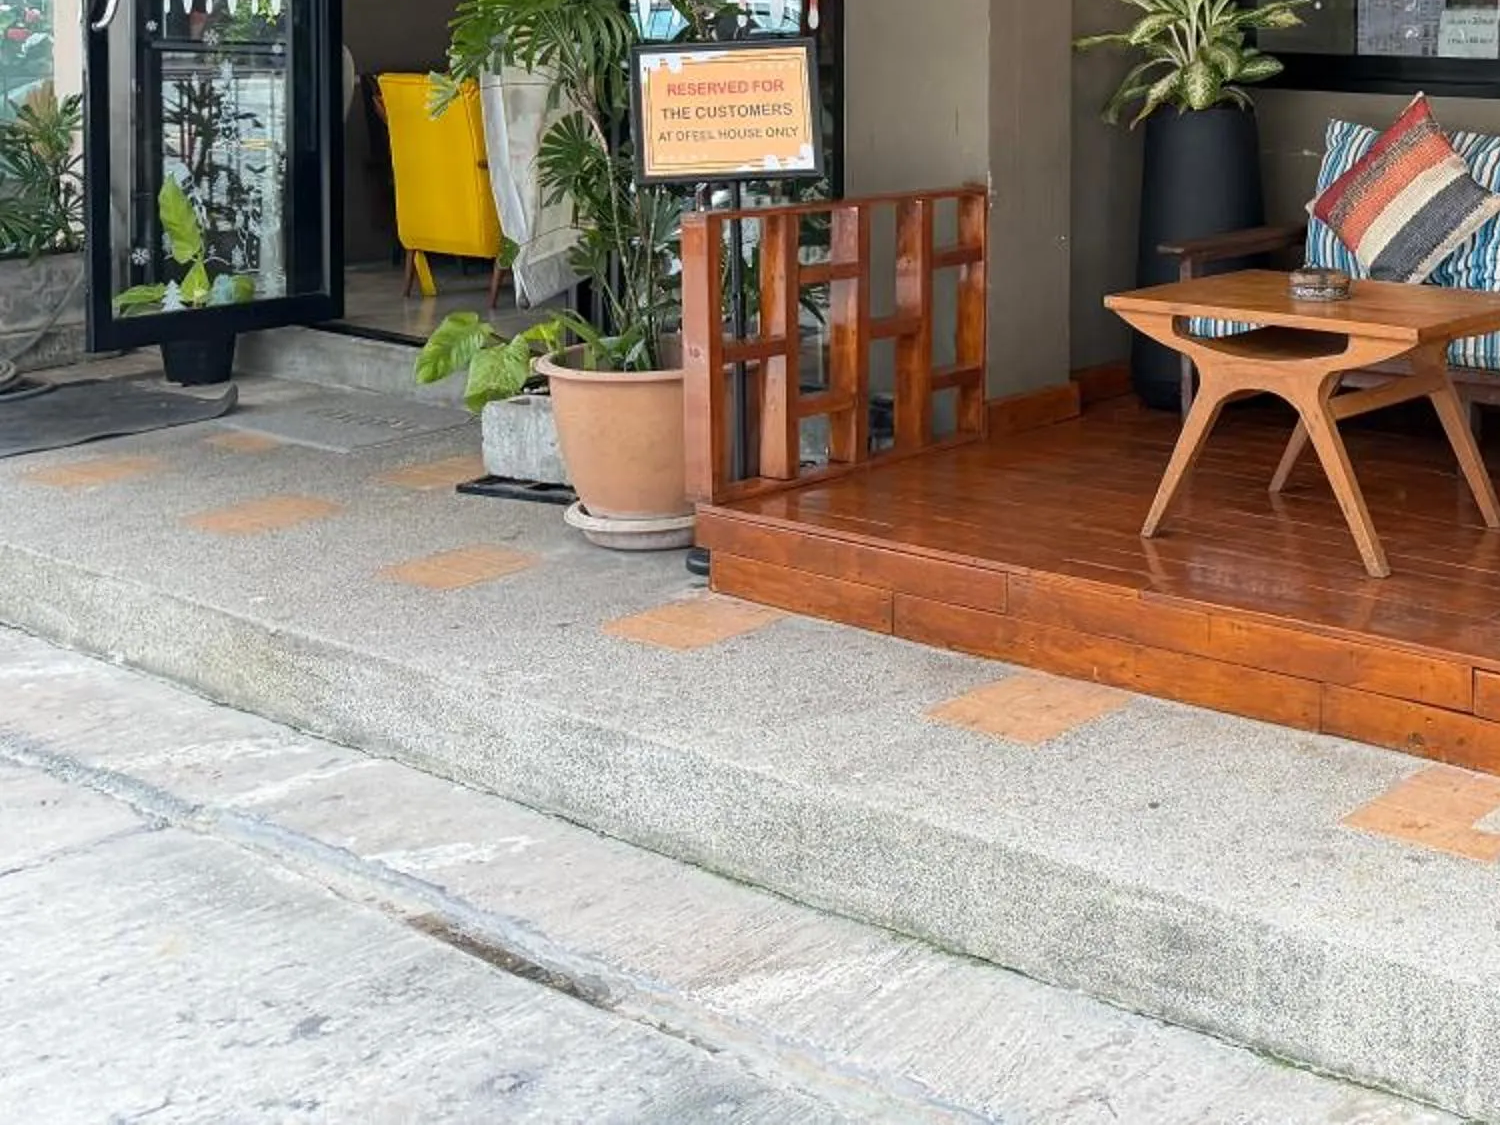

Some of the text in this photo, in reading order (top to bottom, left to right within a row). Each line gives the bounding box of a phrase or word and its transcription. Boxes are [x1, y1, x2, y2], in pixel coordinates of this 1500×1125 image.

[667, 78, 785, 97] RESERVED FOR
[660, 102, 794, 121] THE CUSTOMERS
[657, 130, 672, 143] AT
[718, 128, 763, 141] HOUSE
[765, 126, 800, 139] ONLY
